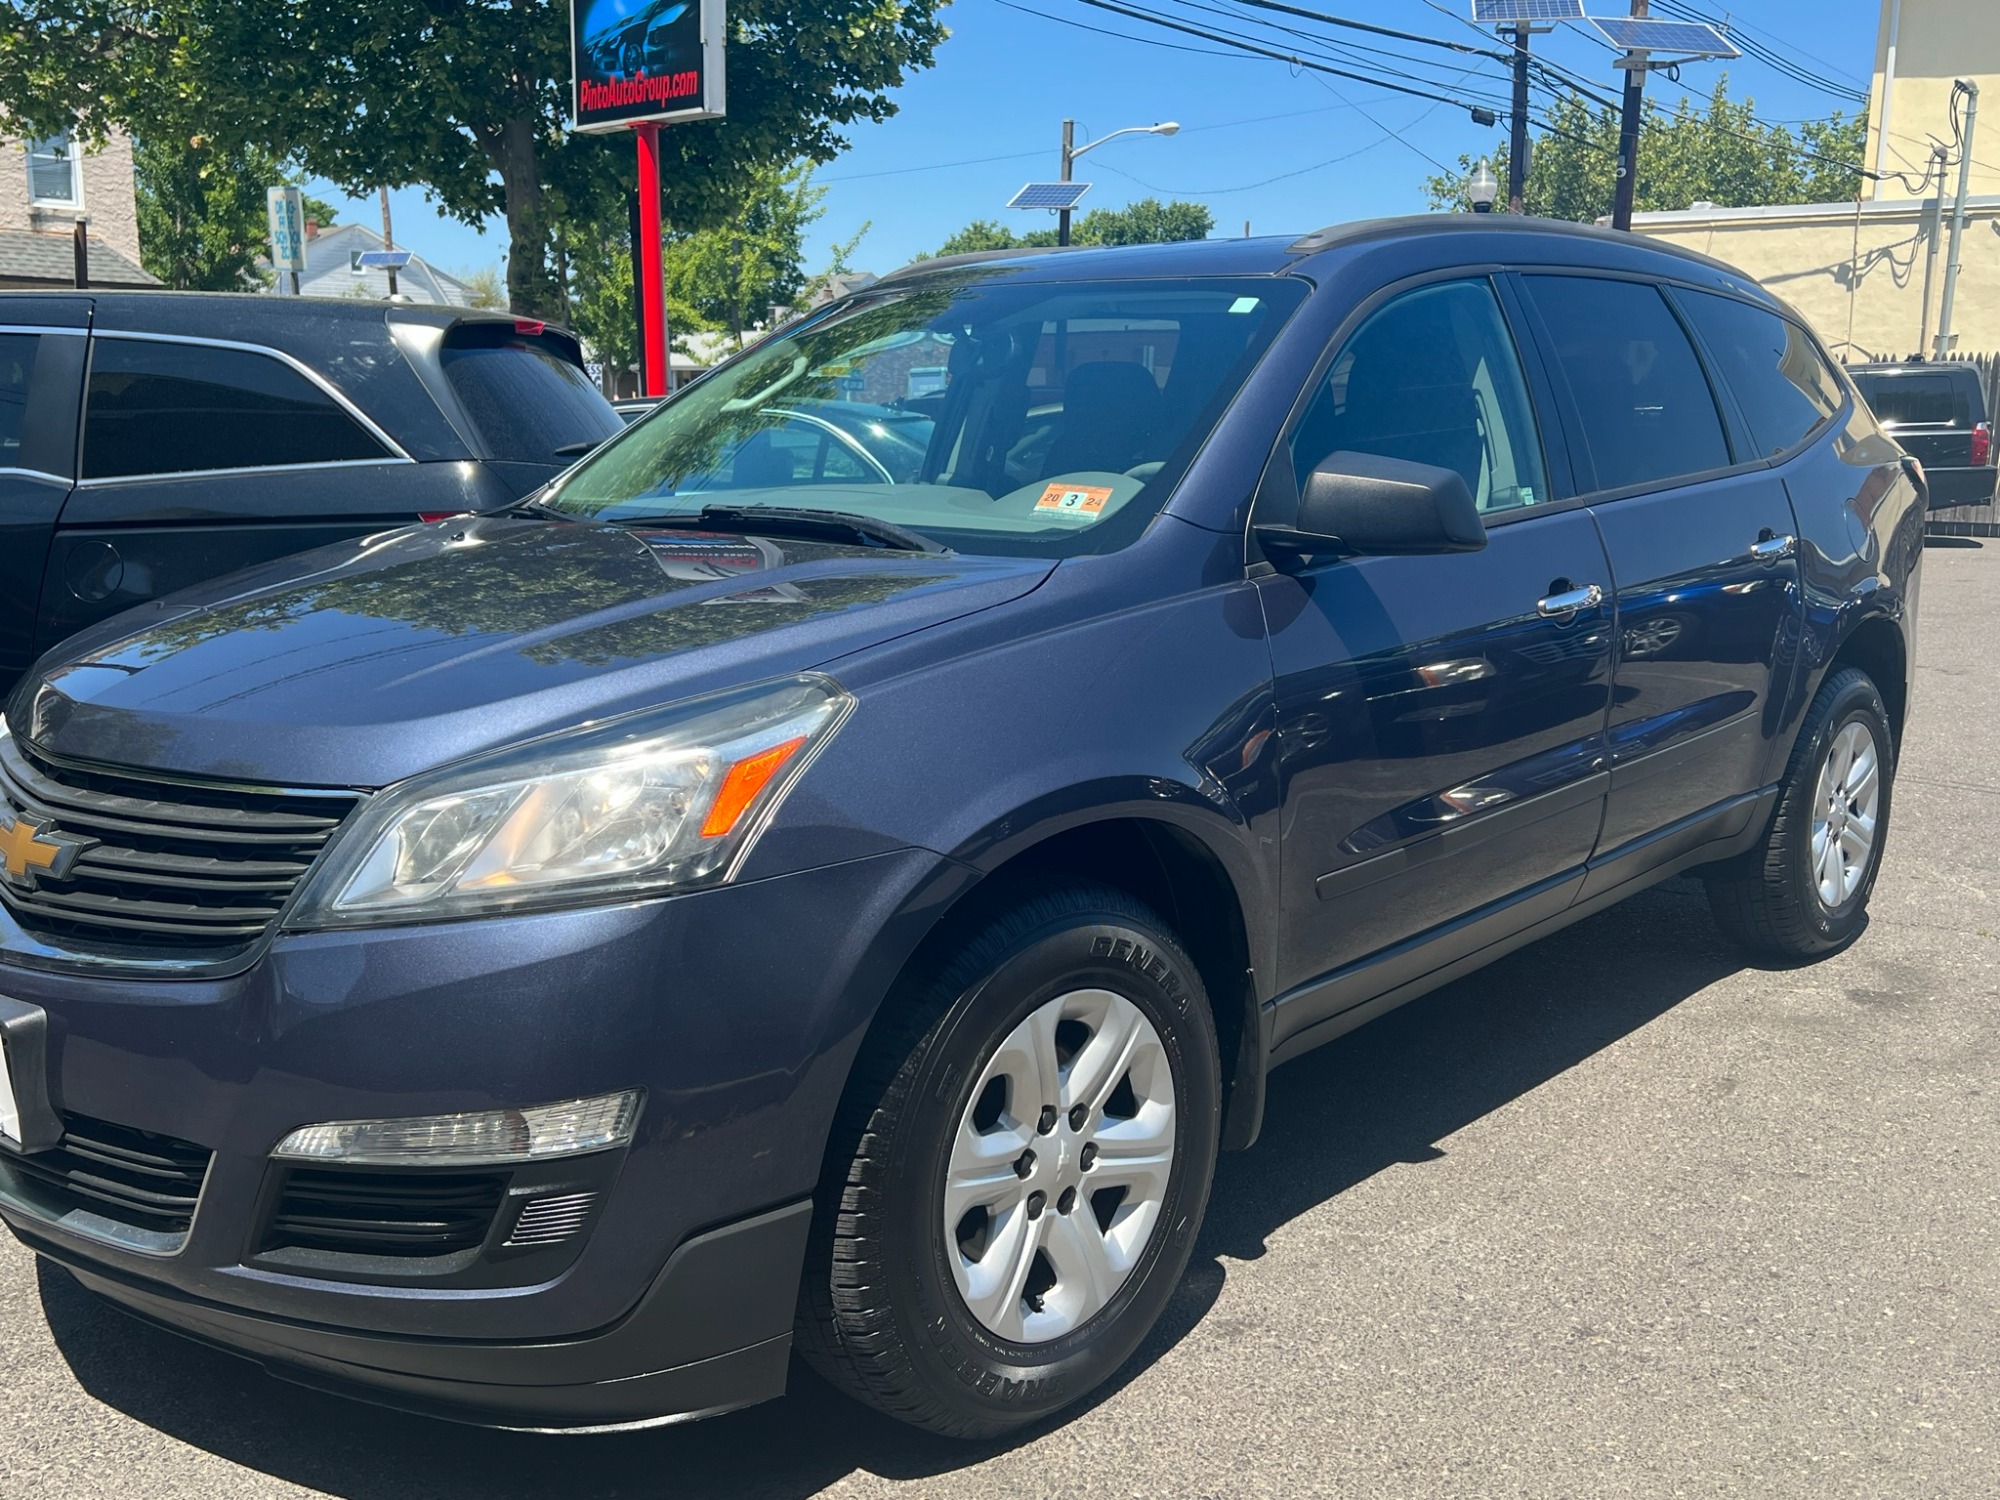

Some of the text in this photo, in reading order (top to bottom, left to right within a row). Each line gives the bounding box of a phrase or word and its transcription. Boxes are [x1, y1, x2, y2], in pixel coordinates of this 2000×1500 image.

[580, 70, 698, 111] PintoAutoGroup.com
[1044, 493, 1104, 507] 20 3 24
